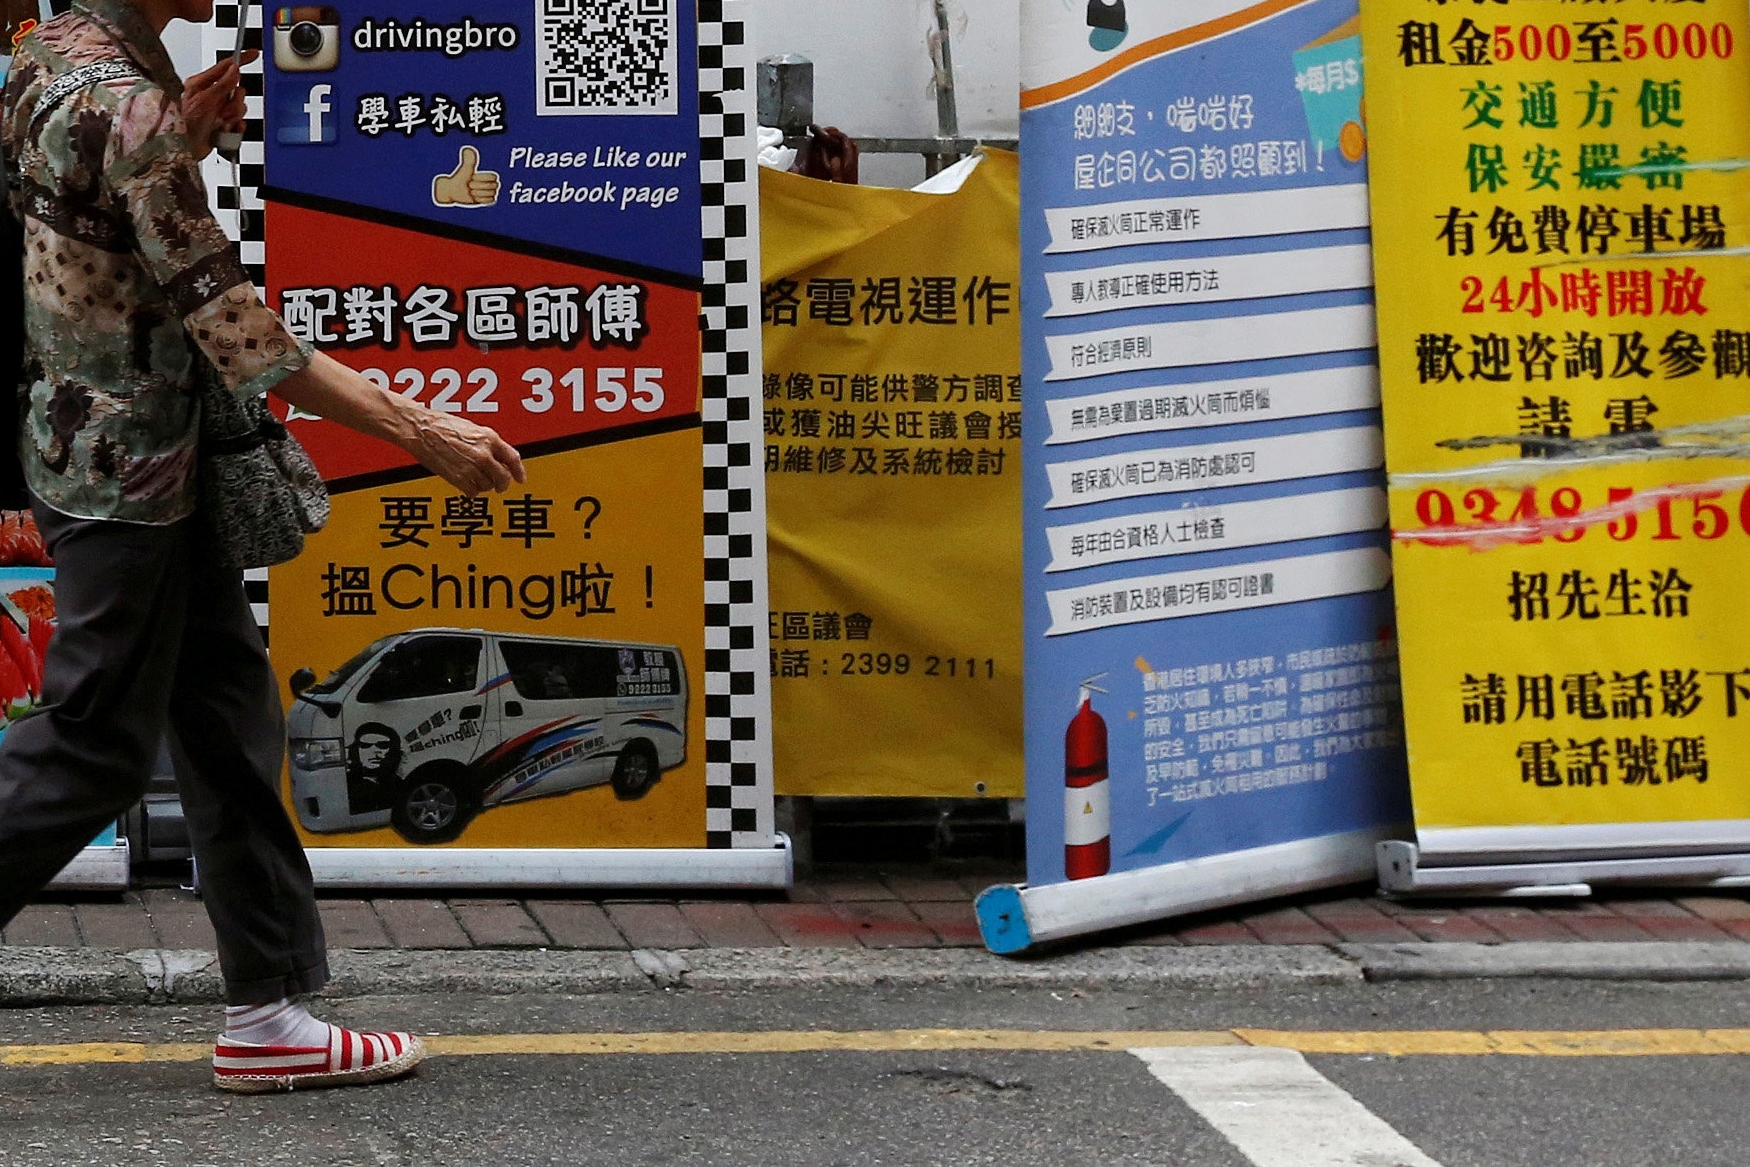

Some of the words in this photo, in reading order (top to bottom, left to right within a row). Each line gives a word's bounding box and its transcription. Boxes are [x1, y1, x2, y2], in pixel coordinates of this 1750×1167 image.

[353, 20, 517, 54] drivingbro
[1398, 17, 1735, 67] 租金500至5000
[356, 96, 506, 135] 學車私輕
[1459, 80, 1684, 131] 交通方便
[509, 146, 589, 169] Please
[592, 146, 639, 168] Like
[645, 151, 687, 168] our
[1464, 141, 1688, 193] 保安嚴密
[509, 182, 616, 205] facebook
[621, 186, 680, 210] page
[1071, 208, 1201, 241] 確保滅火筒正常運作
[1435, 205, 1727, 257] 有免費停車場
[1071, 269, 1220, 305] 專人教導正確使用方法
[1460, 267, 1709, 318] 24小時開放
[282, 284, 643, 343] 配對各區師傅
[520, 366, 666, 414] 3155
[1507, 569, 1694, 620] 招先生洽
[841, 652, 911, 676] 2399
[925, 654, 996, 679] 2111
[1515, 736, 1709, 788] 電話號碼
